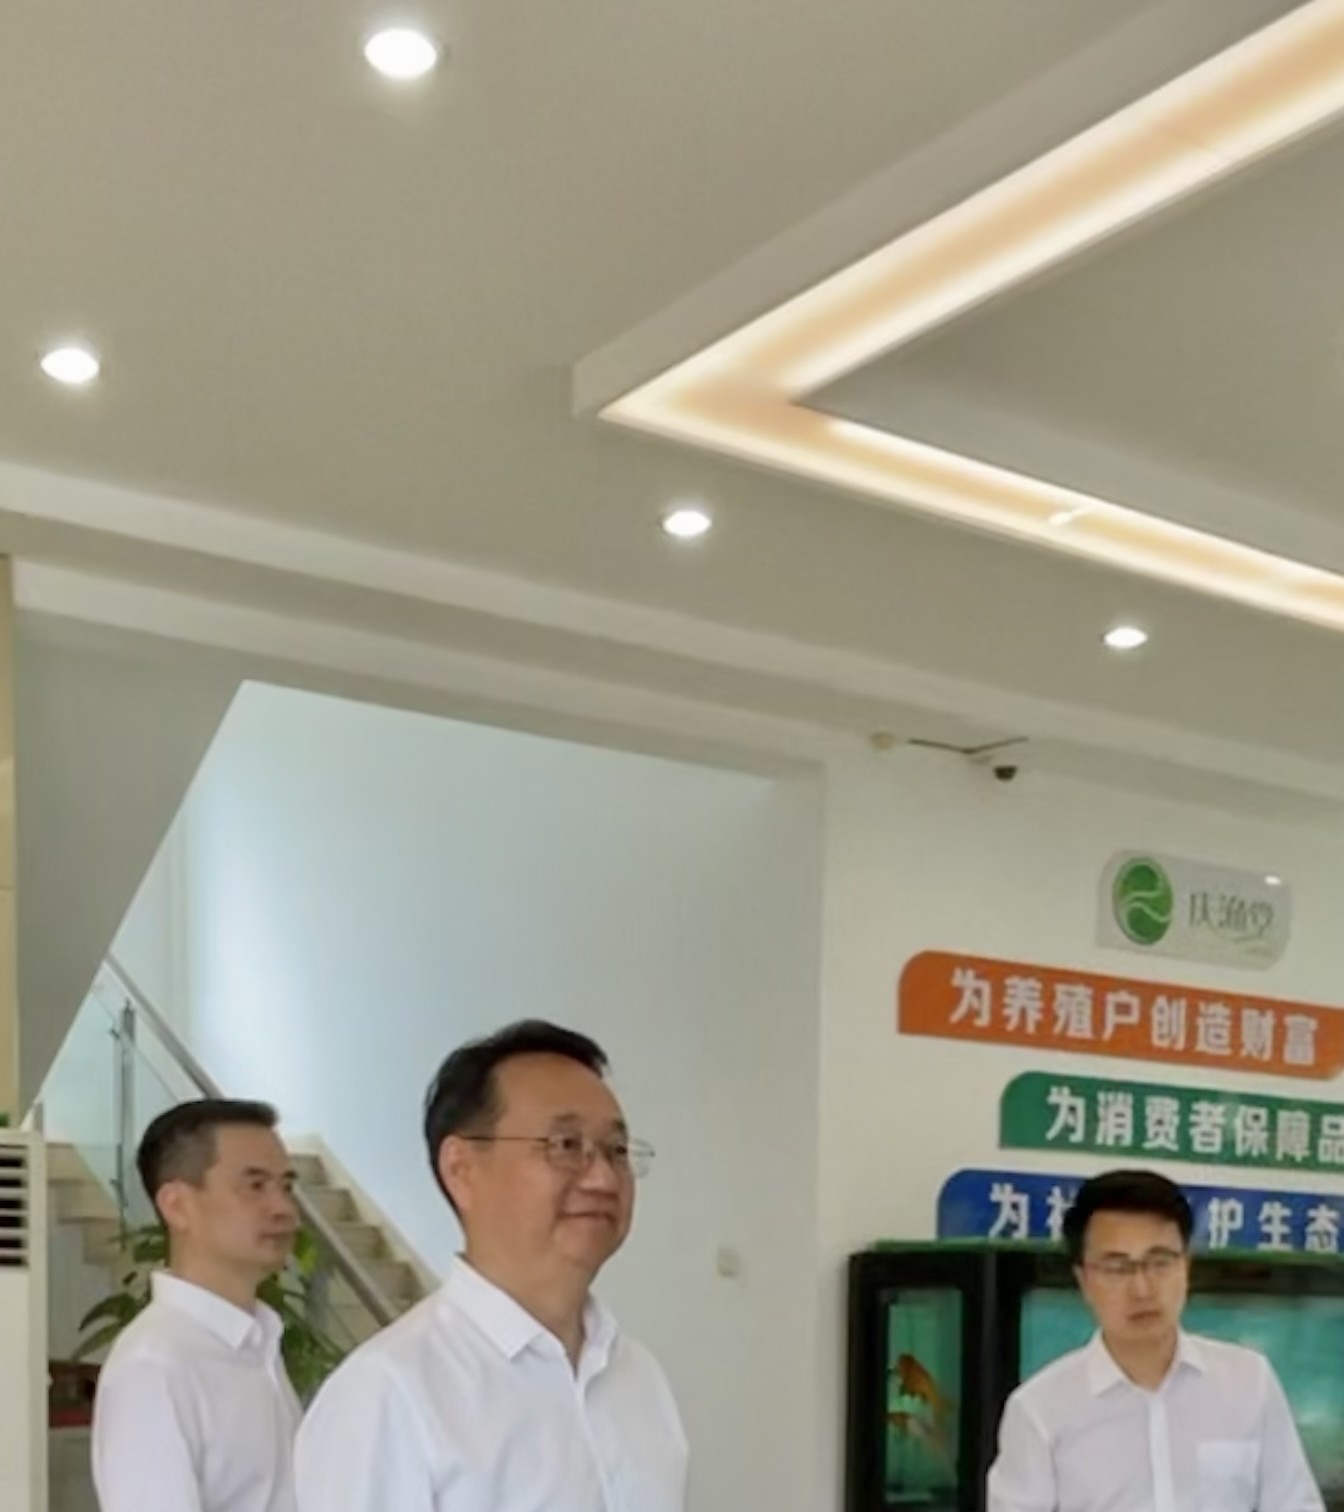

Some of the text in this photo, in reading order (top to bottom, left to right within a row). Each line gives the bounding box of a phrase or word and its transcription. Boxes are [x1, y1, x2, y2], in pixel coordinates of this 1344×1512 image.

[949, 968, 1319, 1067] 为养殖户创造财富
